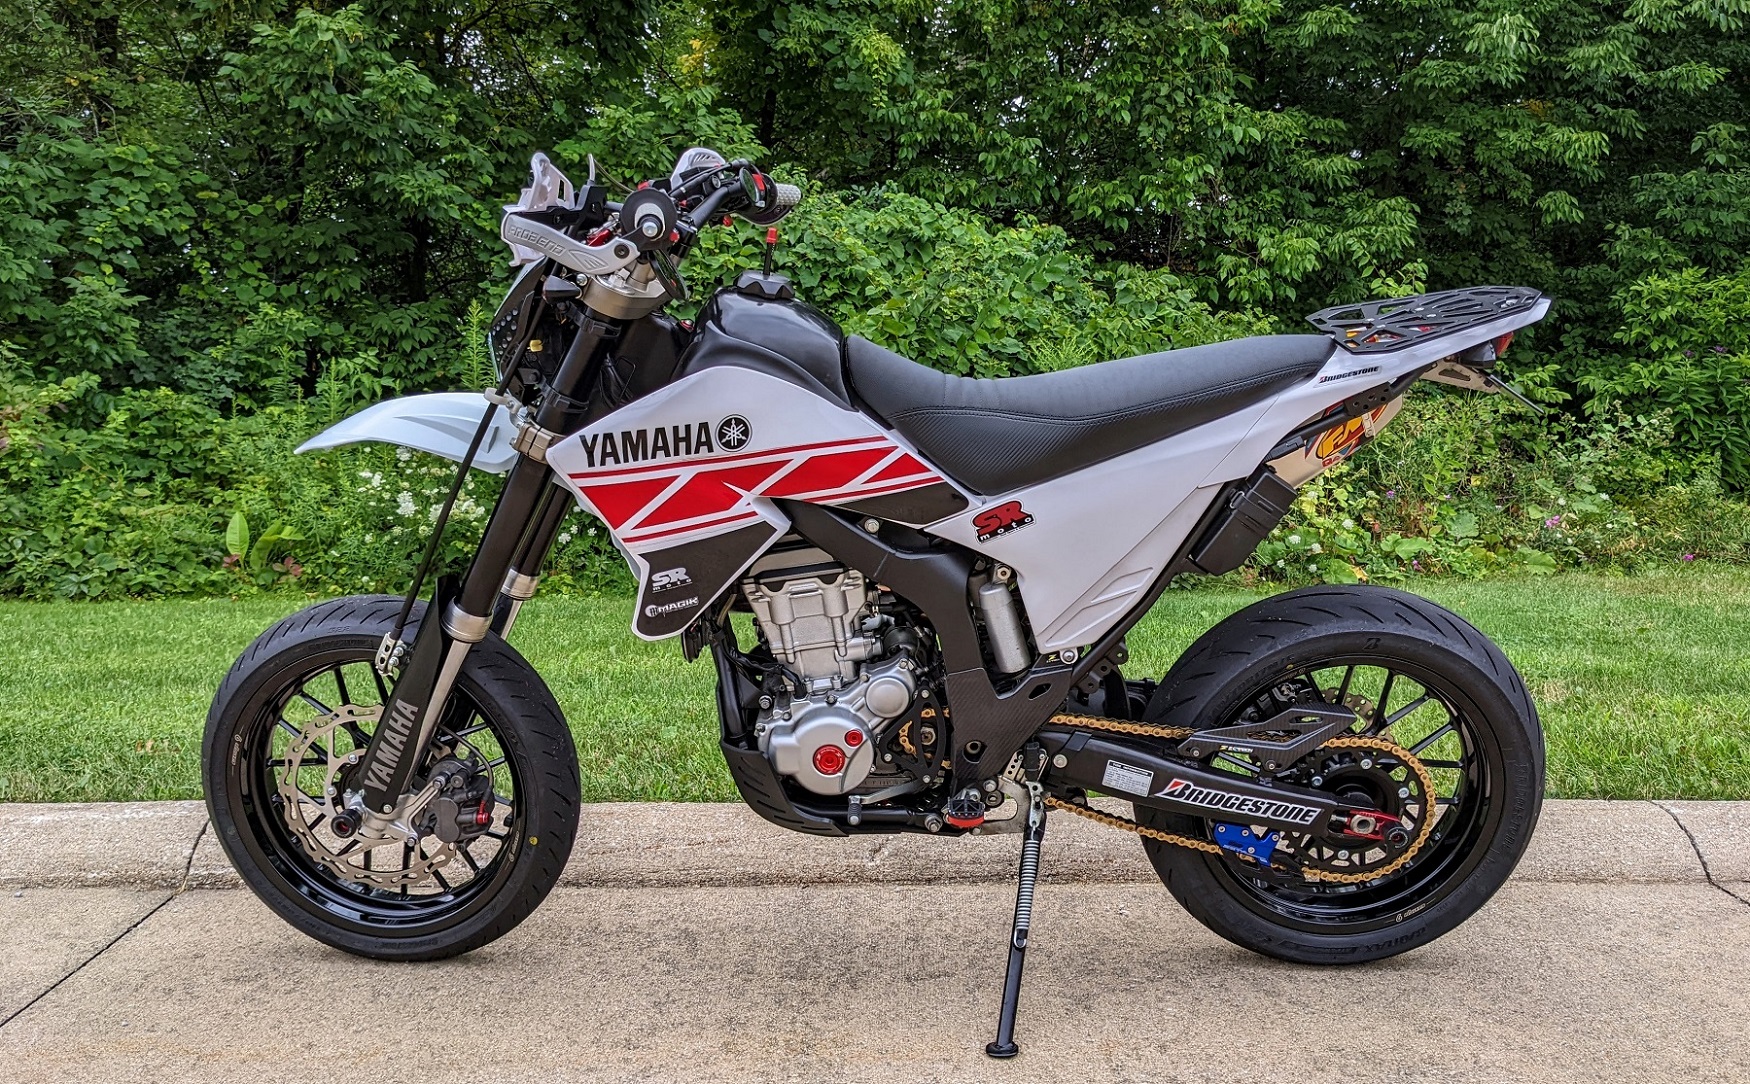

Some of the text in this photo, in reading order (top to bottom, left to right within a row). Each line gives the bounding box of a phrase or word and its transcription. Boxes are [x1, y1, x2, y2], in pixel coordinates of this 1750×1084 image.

[1319, 366, 1379, 384] BRIDGESTONE
[579, 422, 714, 468] YAMAHA
[973, 501, 1029, 535] SR
[980, 517, 1032, 541] moto
[651, 567, 690, 587] SR
[658, 596, 699, 613] MAGIK
[364, 699, 419, 792] YAMAHA
[1160, 779, 1320, 824] BRIDGESTONE
